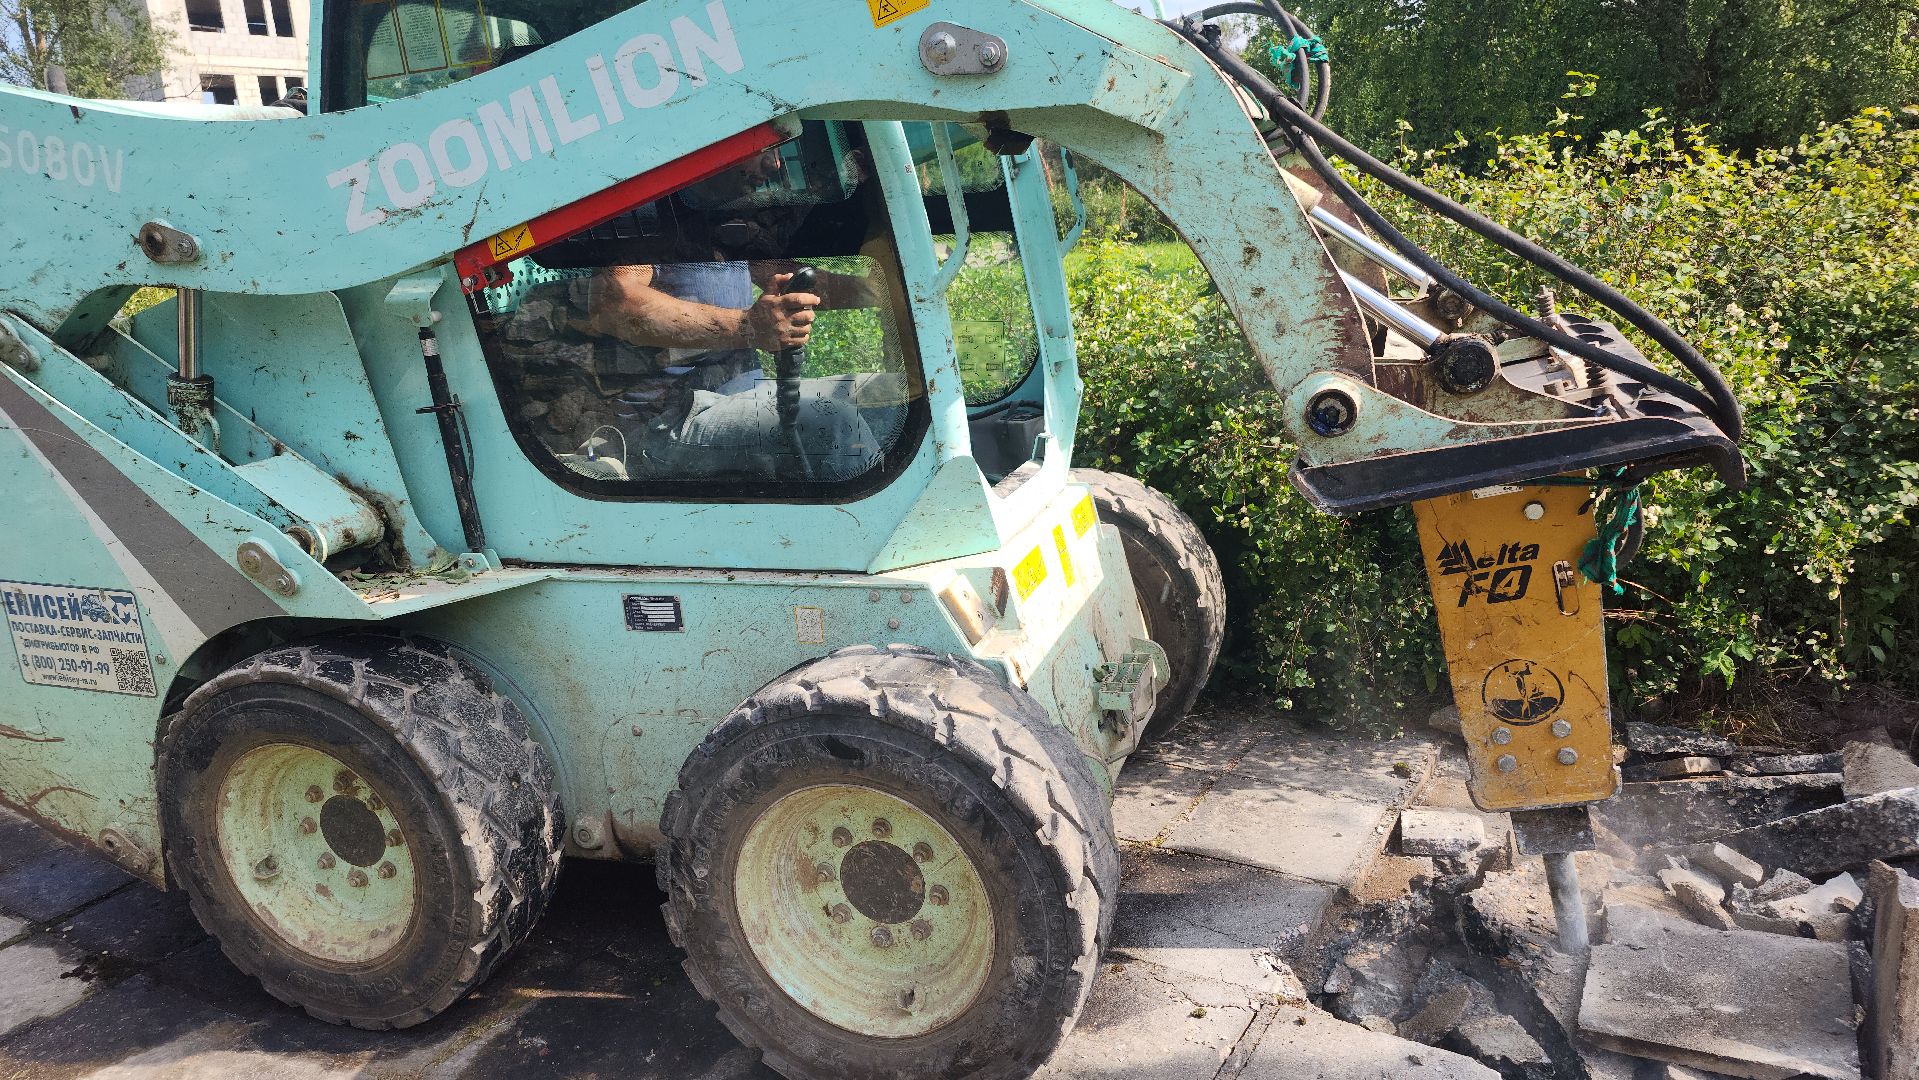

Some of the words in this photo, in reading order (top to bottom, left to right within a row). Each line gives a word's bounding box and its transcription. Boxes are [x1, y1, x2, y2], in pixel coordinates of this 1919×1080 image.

[326, 0, 746, 235] ZOOMLION
[3, 591, 83, 621] ЕНИСЕЙ
[58, 658, 110, 675] 250-97-99
